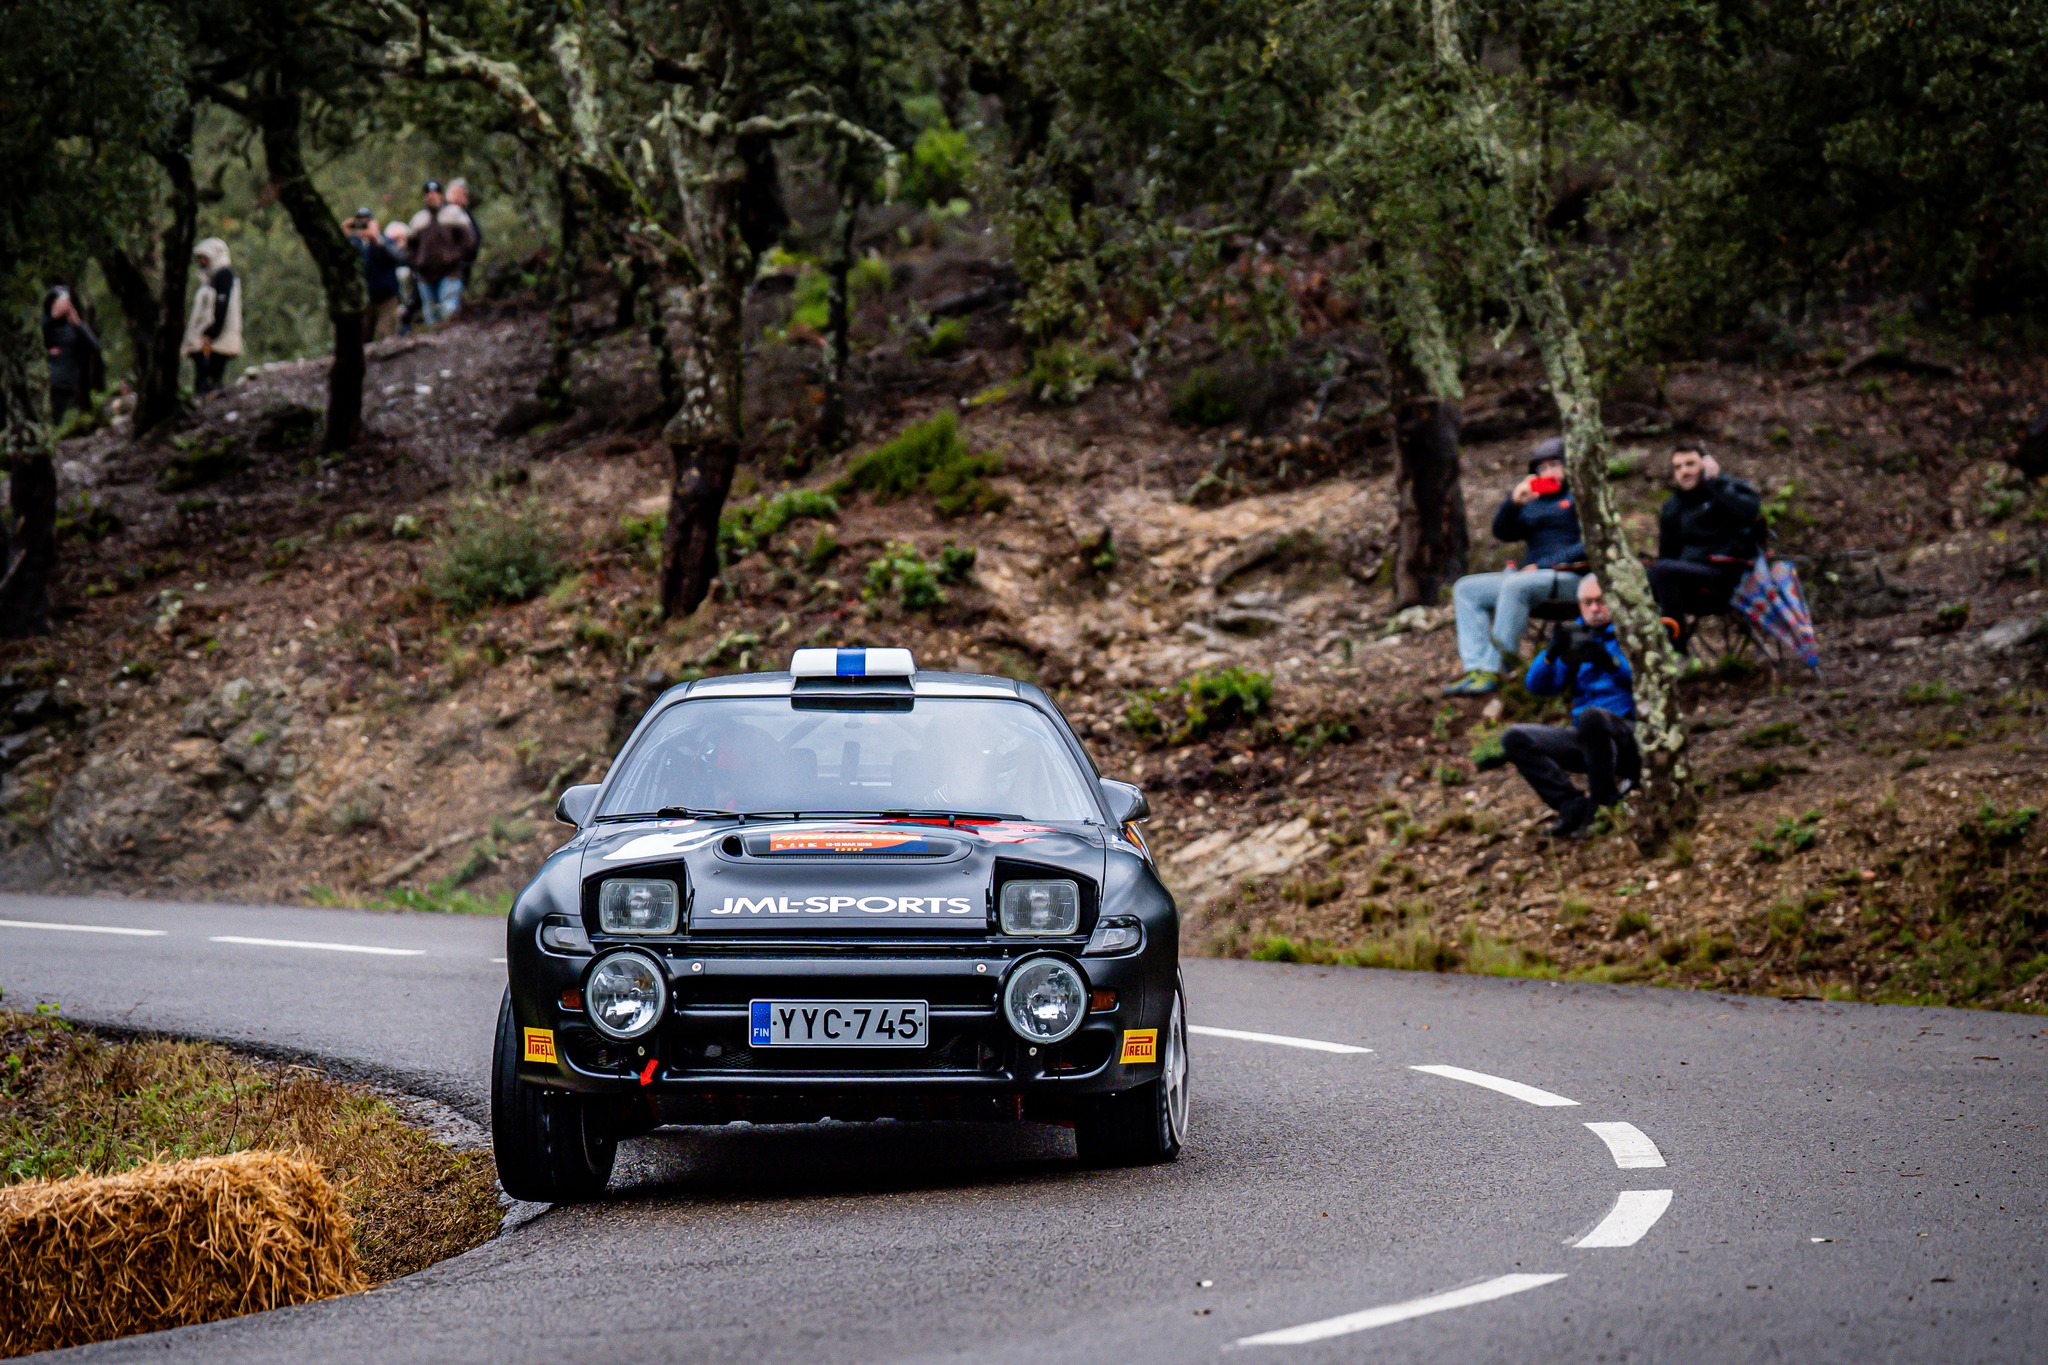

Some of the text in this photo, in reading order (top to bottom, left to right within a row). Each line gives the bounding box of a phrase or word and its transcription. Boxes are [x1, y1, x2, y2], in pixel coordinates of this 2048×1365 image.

[711, 896, 971, 914] JML-SPORTS
[754, 1027, 770, 1037] FIN
[1124, 1036, 1153, 1056] PIRELLI
